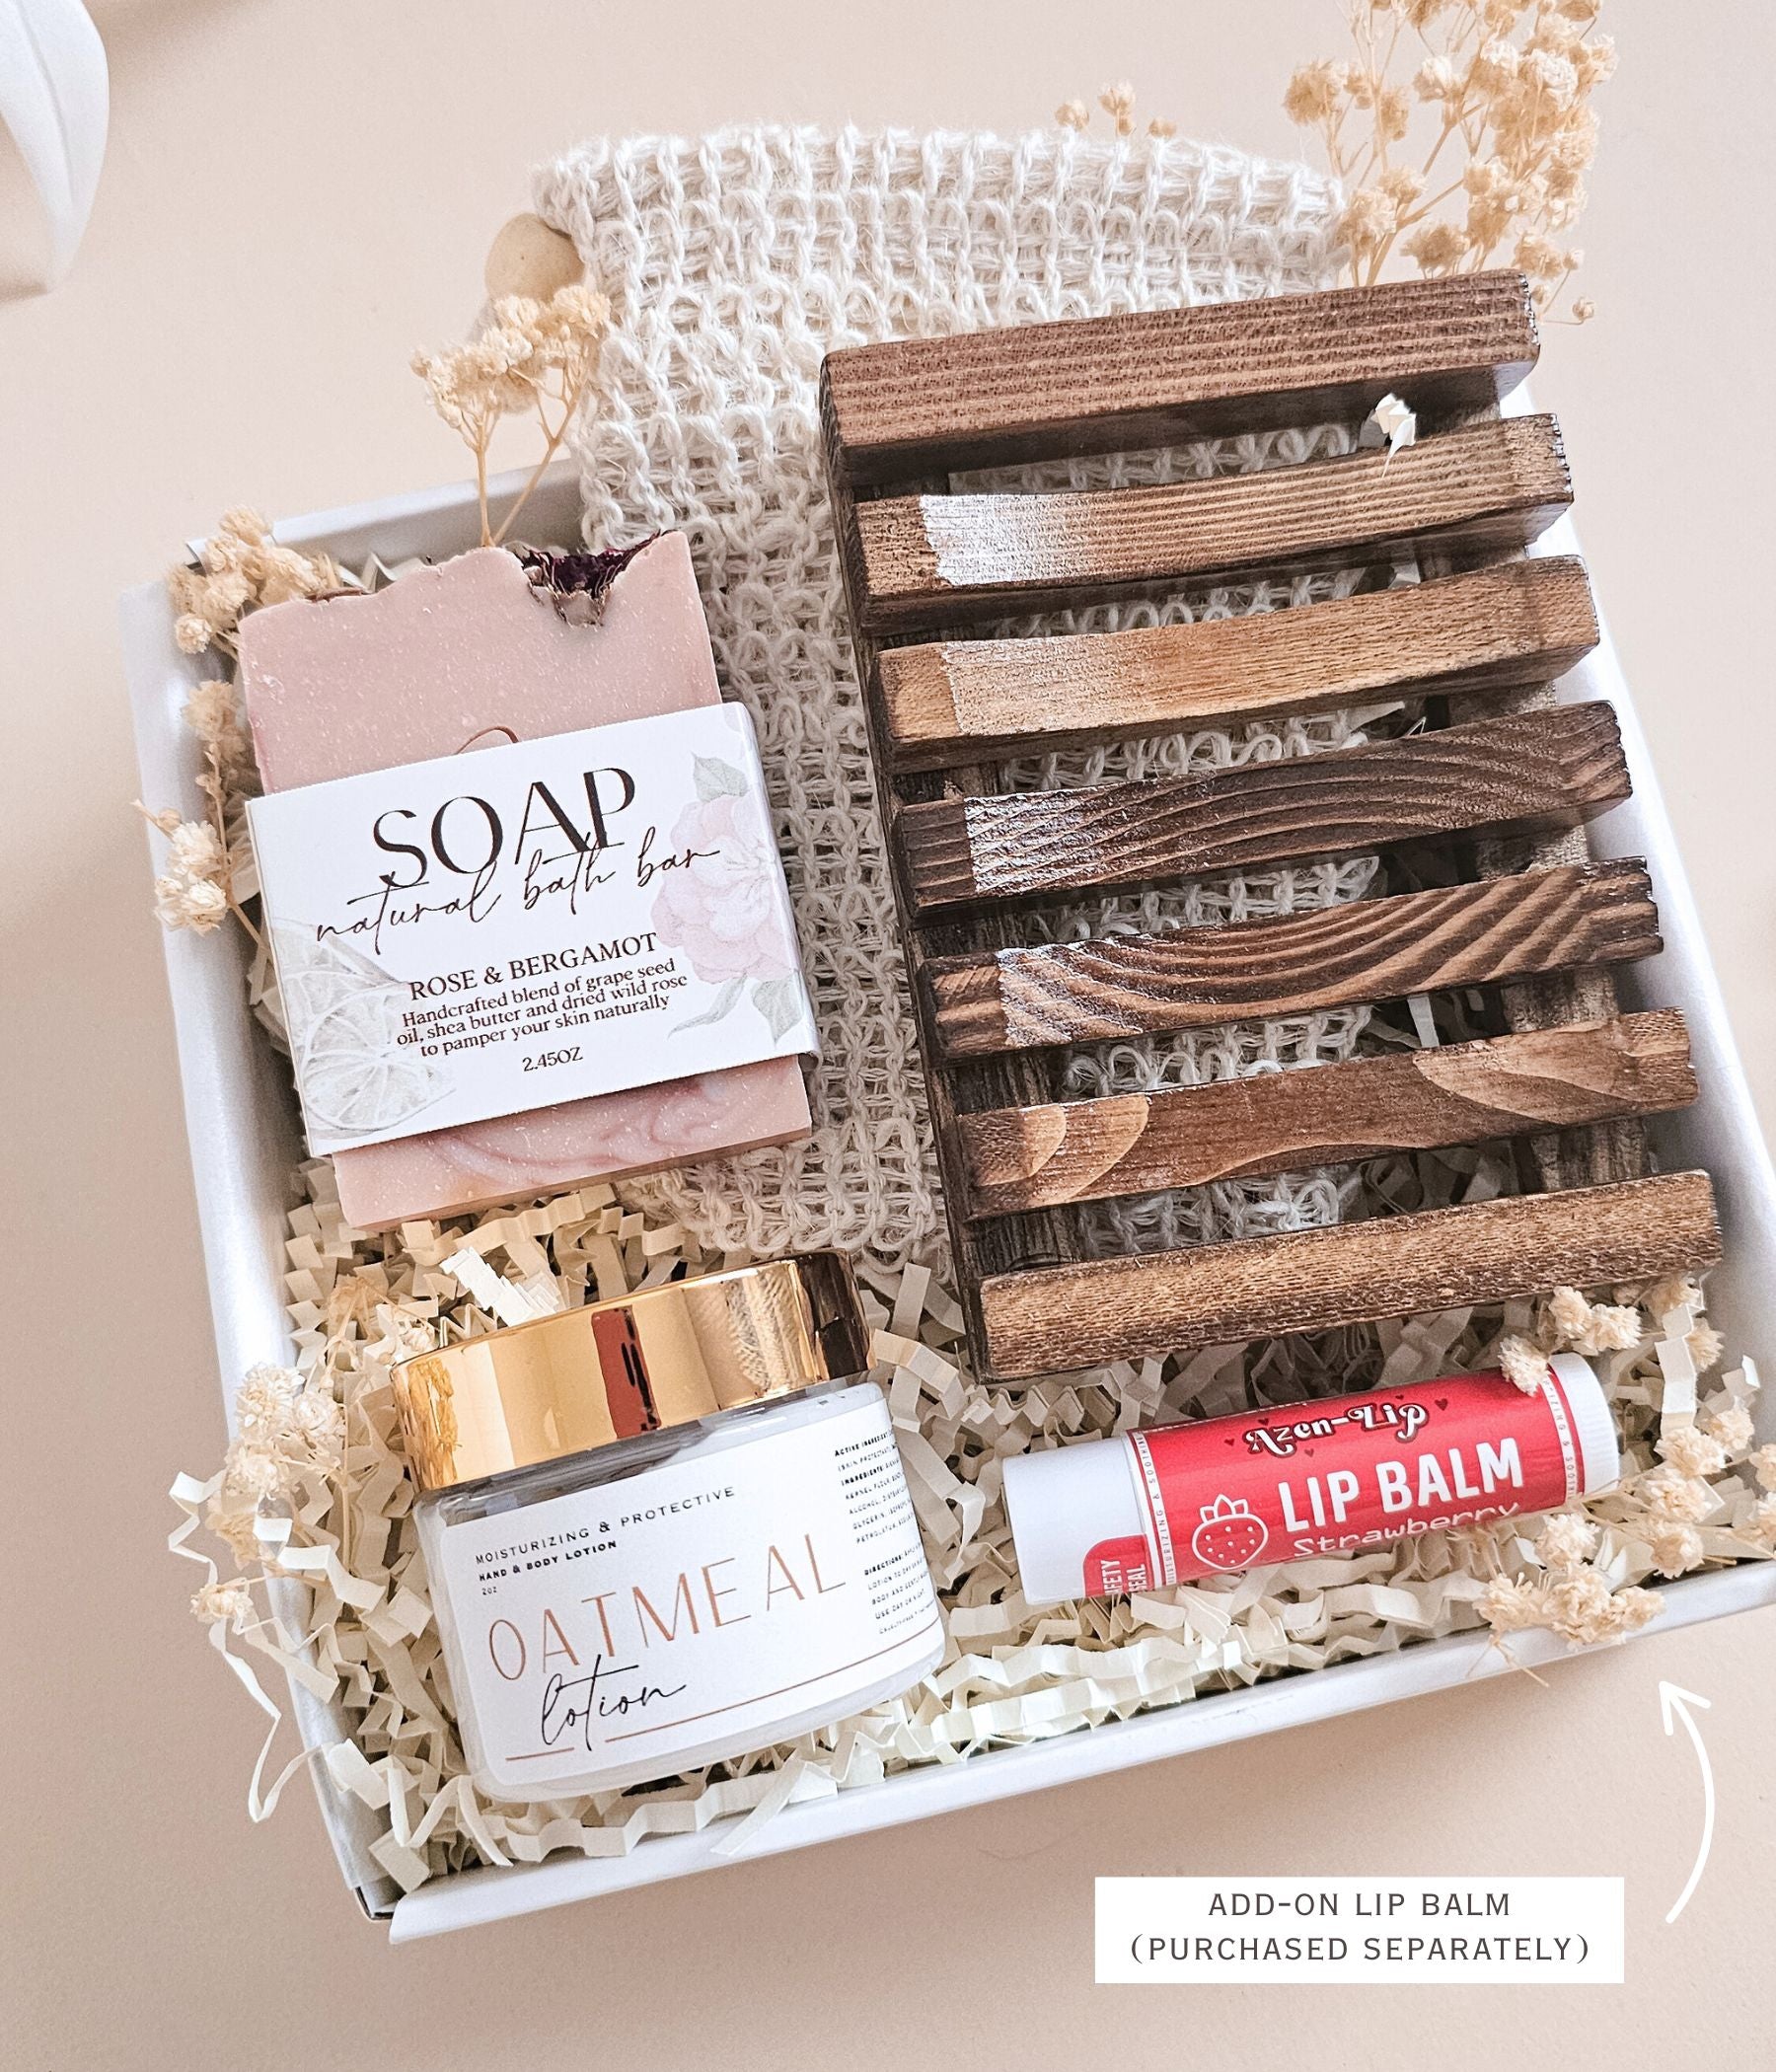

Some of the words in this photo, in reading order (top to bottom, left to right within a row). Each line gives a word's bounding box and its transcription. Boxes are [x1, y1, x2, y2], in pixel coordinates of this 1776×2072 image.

[372, 767, 636, 887] SOAP
[316, 859, 502, 955] natural
[523, 831, 624, 916] bath
[636, 827, 721, 888] bar
[402, 993, 508, 1027] Handcrafted
[512, 985, 559, 1004] blend
[564, 976, 583, 994] of
[586, 969, 633, 994] grape
[638, 958, 675, 979] seed
[409, 970, 478, 1000] ROSE
[483, 966, 504, 985] &
[508, 932, 657, 980] BERGAMOT
[397, 1028, 424, 1046] oil,
[427, 1020, 466, 1039] shea
[471, 1009, 521, 1030] butter
[526, 999, 557, 1017] and
[562, 989, 606, 1009] dried
[612, 980, 647, 999] wild
[652, 975, 688, 993] rose
[421, 1044, 439, 1057] to
[443, 1029, 506, 1056] pamper
[511, 1021, 551, 1041] your
[555, 1010, 590, 1028] skin
[594, 994, 670, 1021] naturally
[522, 1046, 584, 1072] 2.45OZ
[1244, 1402, 1428, 1456] Azen-Lip
[1278, 1470, 1360, 1532] LIP
[1375, 1438, 1523, 1513] BALM
[475, 1527, 589, 1565] MOISTURIZING
[599, 1521, 611, 1533] &
[621, 1486, 735, 1527] PROTECTIVE
[1294, 1502, 1519, 1557] Strawberry
[479, 1569, 507, 1582] HAND
[512, 1564, 522, 1574] &
[526, 1556, 559, 1571] BODY
[565, 1540, 618, 1561] LOTION
[488, 1533, 847, 1681] OATMEAL
[541, 1654, 688, 1751] lotion
